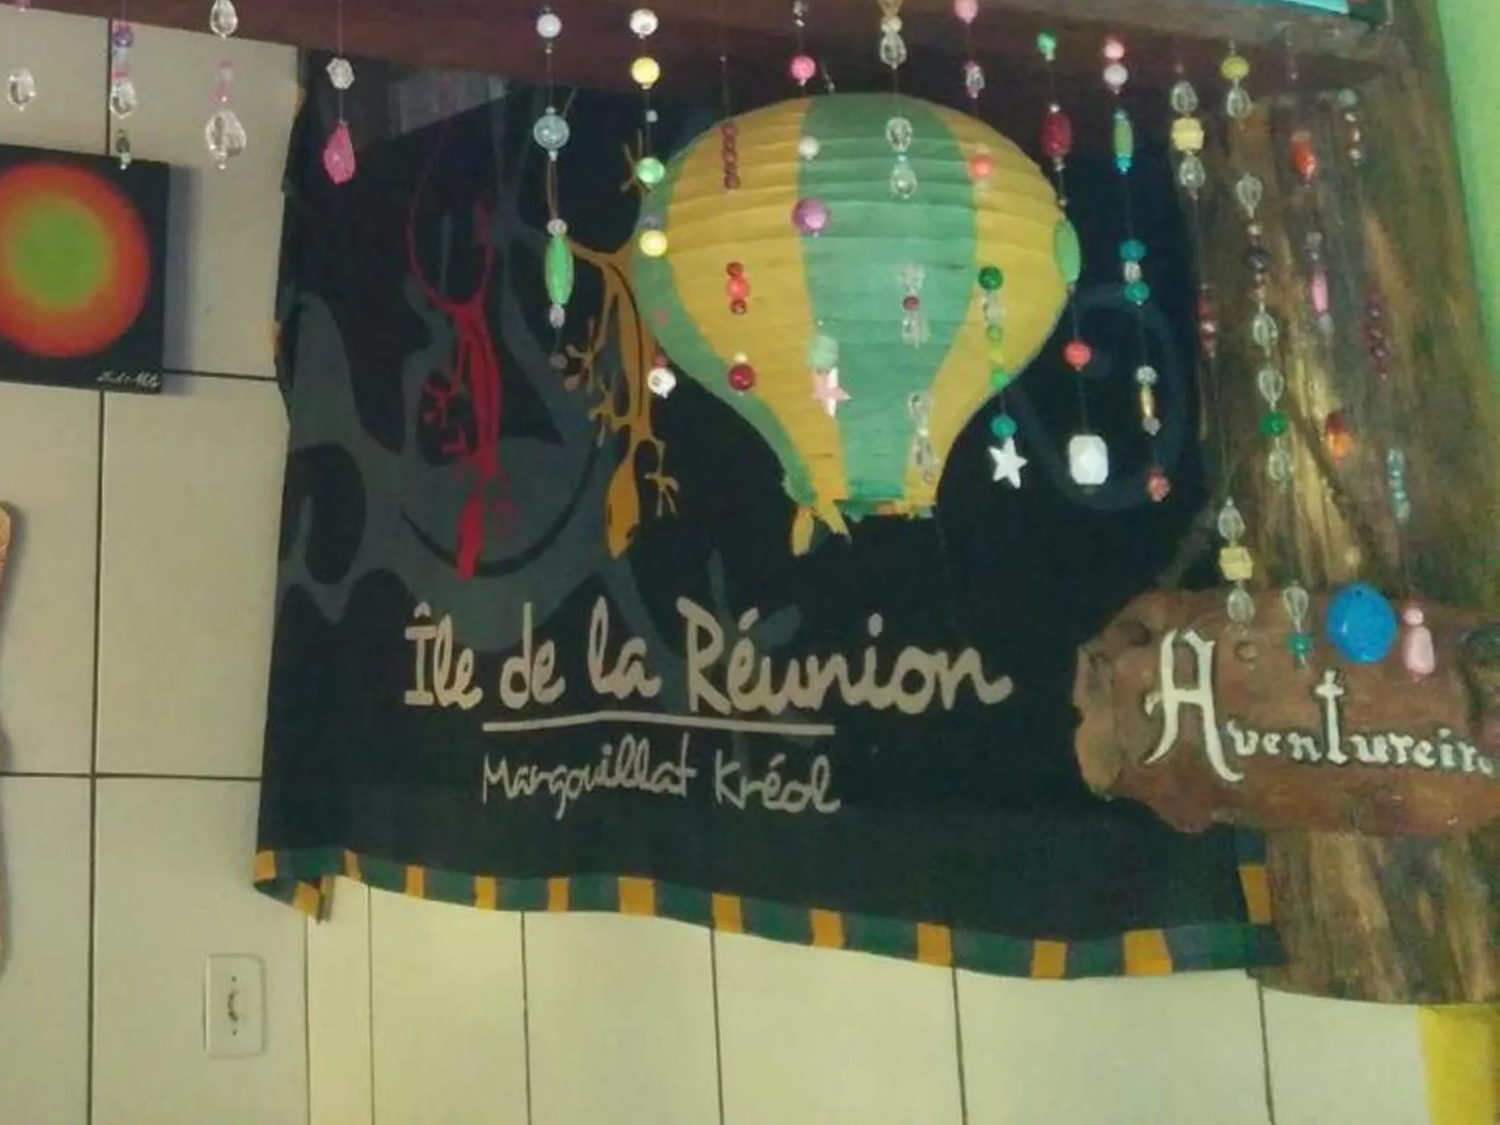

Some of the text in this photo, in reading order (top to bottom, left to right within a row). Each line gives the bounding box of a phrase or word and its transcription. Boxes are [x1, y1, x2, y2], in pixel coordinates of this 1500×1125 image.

[404, 596, 1013, 715] Île de la Réunion
[714, 749, 841, 813] Kréol
